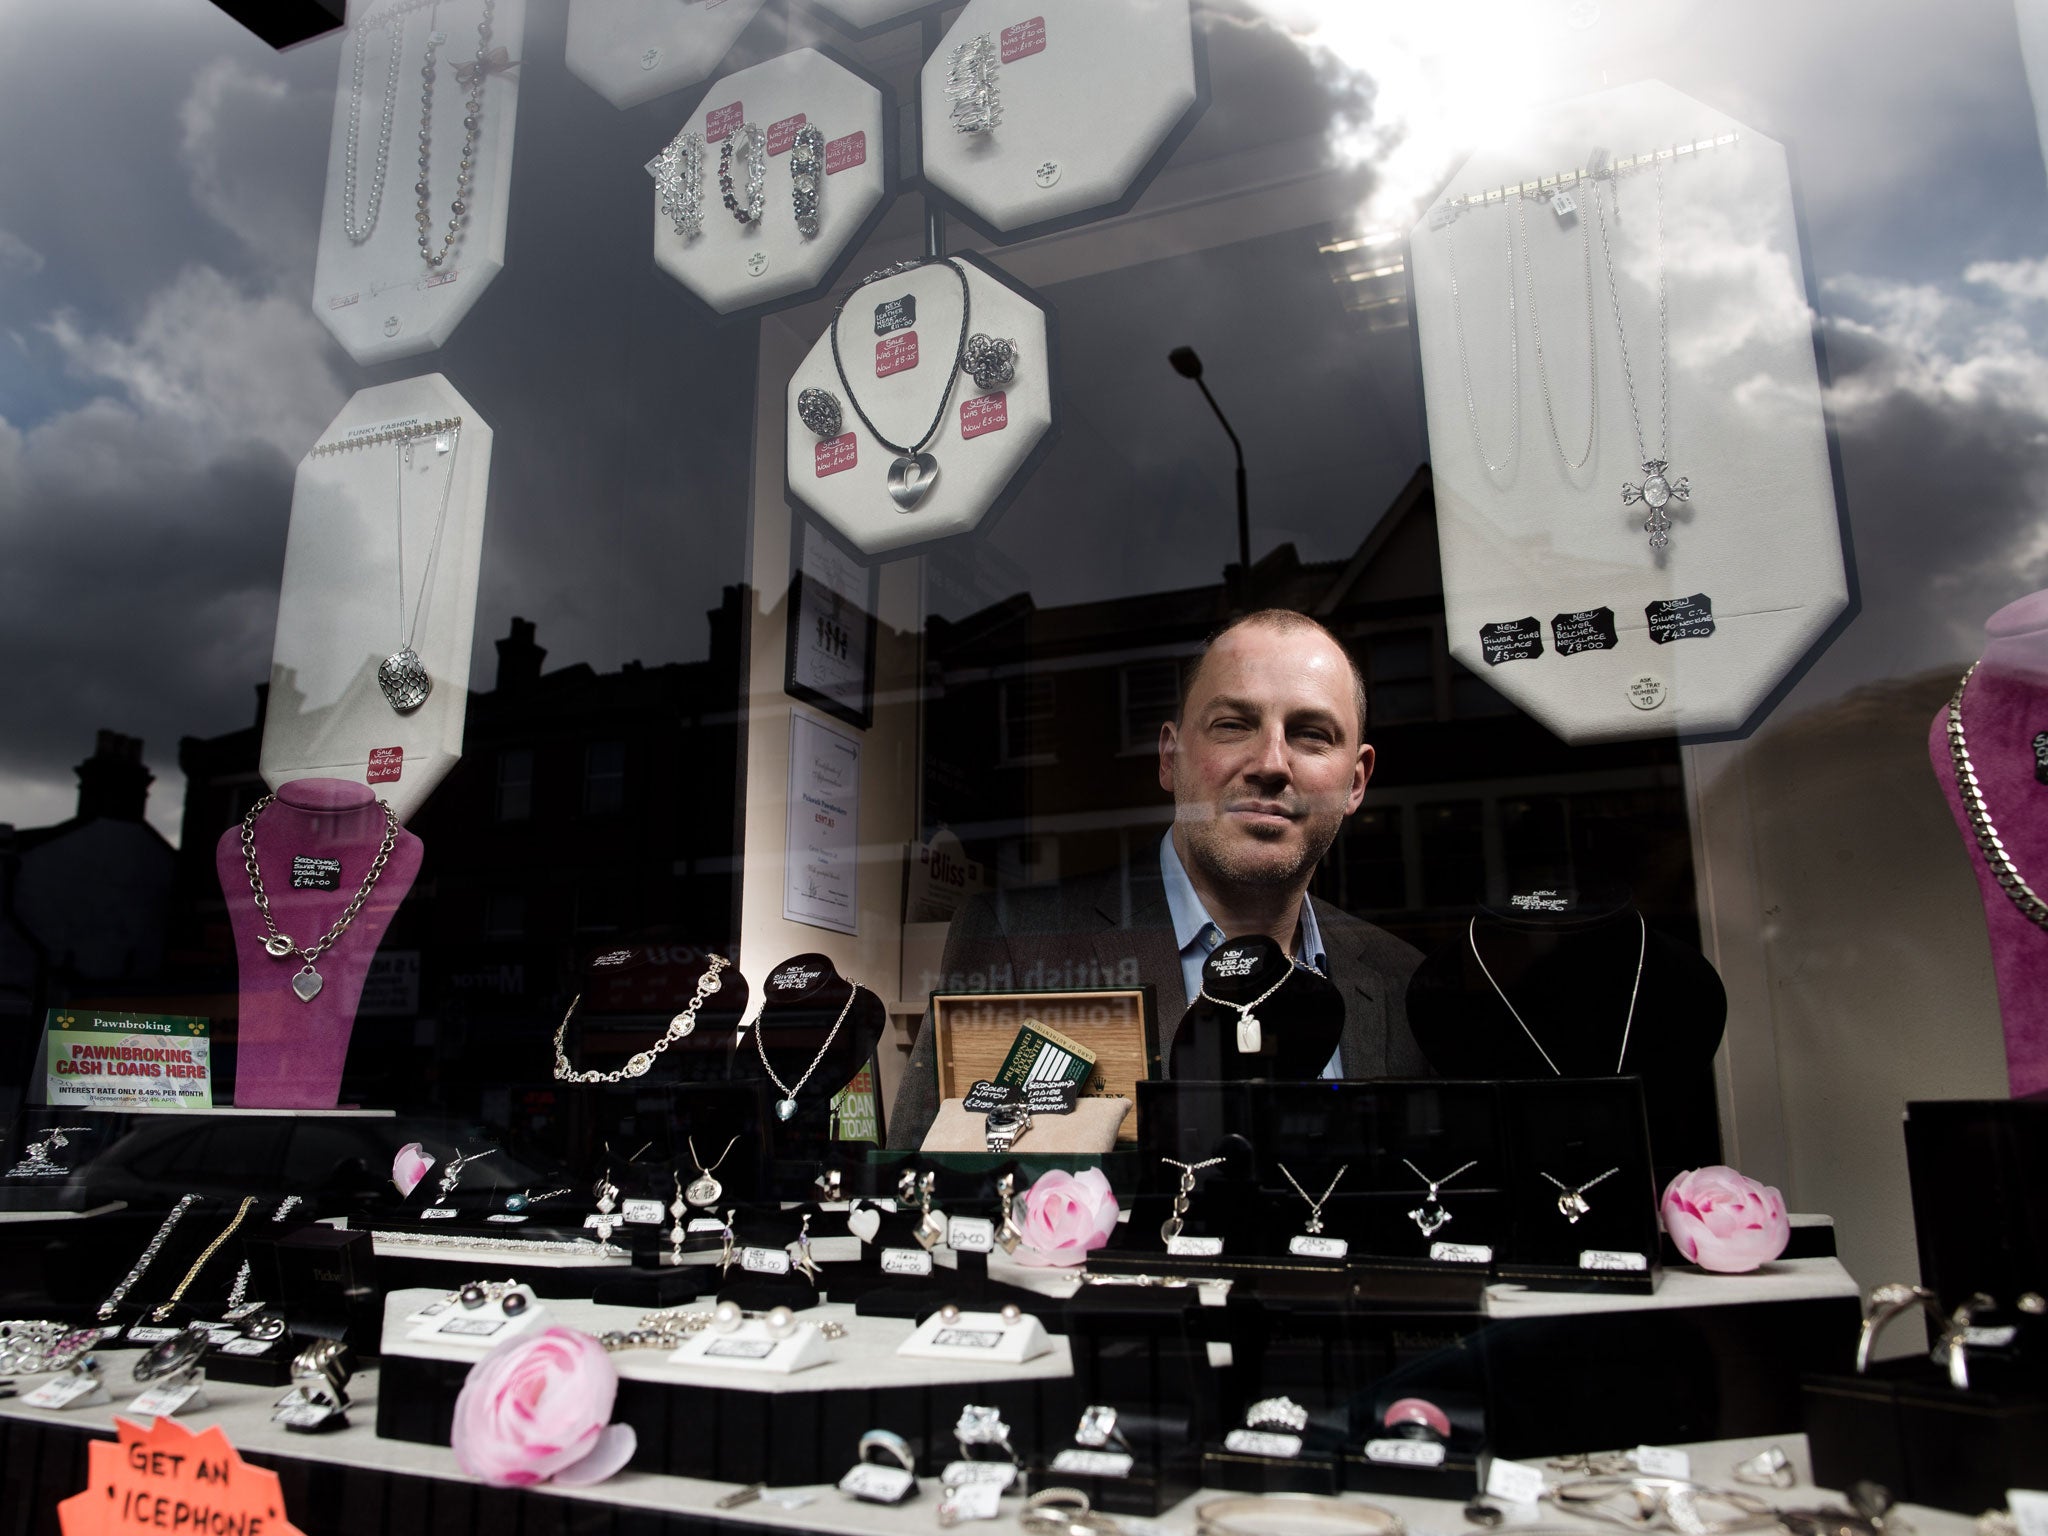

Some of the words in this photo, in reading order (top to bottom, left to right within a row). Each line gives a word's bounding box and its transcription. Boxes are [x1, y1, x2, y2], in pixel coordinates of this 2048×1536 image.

[348, 426, 376, 437] FUNKY
[381, 418, 418, 431] FASHION
[963, 422, 981, 432] NOW
[1662, 597, 1689, 608] NEW
[1573, 611, 1593, 620] NEW
[1496, 622, 1518, 631] NEW
[1518, 632, 1540, 640] CURB
[1557, 633, 1607, 647] NECKLACE
[1661, 627, 1710, 642] £43-00
[1487, 641, 1532, 651] NECKLACE
[1567, 642, 1604, 654] £8-00
[1493, 651, 1528, 663] £5-00
[1633, 688, 1659, 696] NUMBER
[1641, 696, 1653, 705] 10
[931, 850, 965, 887] Bliss
[94, 1018, 171, 1033] Pawnbroking
[72, 1045, 192, 1063] PAWNBROKING
[1003, 1033, 1032, 1082] PRE-OWNED
[1014, 1045, 1035, 1075] ROLEX
[1015, 1038, 1044, 1086] GUARANTEE
[56, 1060, 102, 1075] CASH
[107, 1062, 161, 1077] LOANS
[165, 1064, 207, 1079] HERE
[976, 1081, 1010, 1093] ROLEX
[1028, 1080, 1076, 1090] SECONDHAND
[972, 1090, 1007, 1099] WATCH
[1028, 1088, 1062, 1097] LADIES
[1029, 1095, 1063, 1104] OYSTER
[842, 1095, 875, 1117] LOAN
[843, 1119, 876, 1138] TODAY!
[129, 1442, 185, 1478] GET
[196, 1458, 229, 1486] AN
